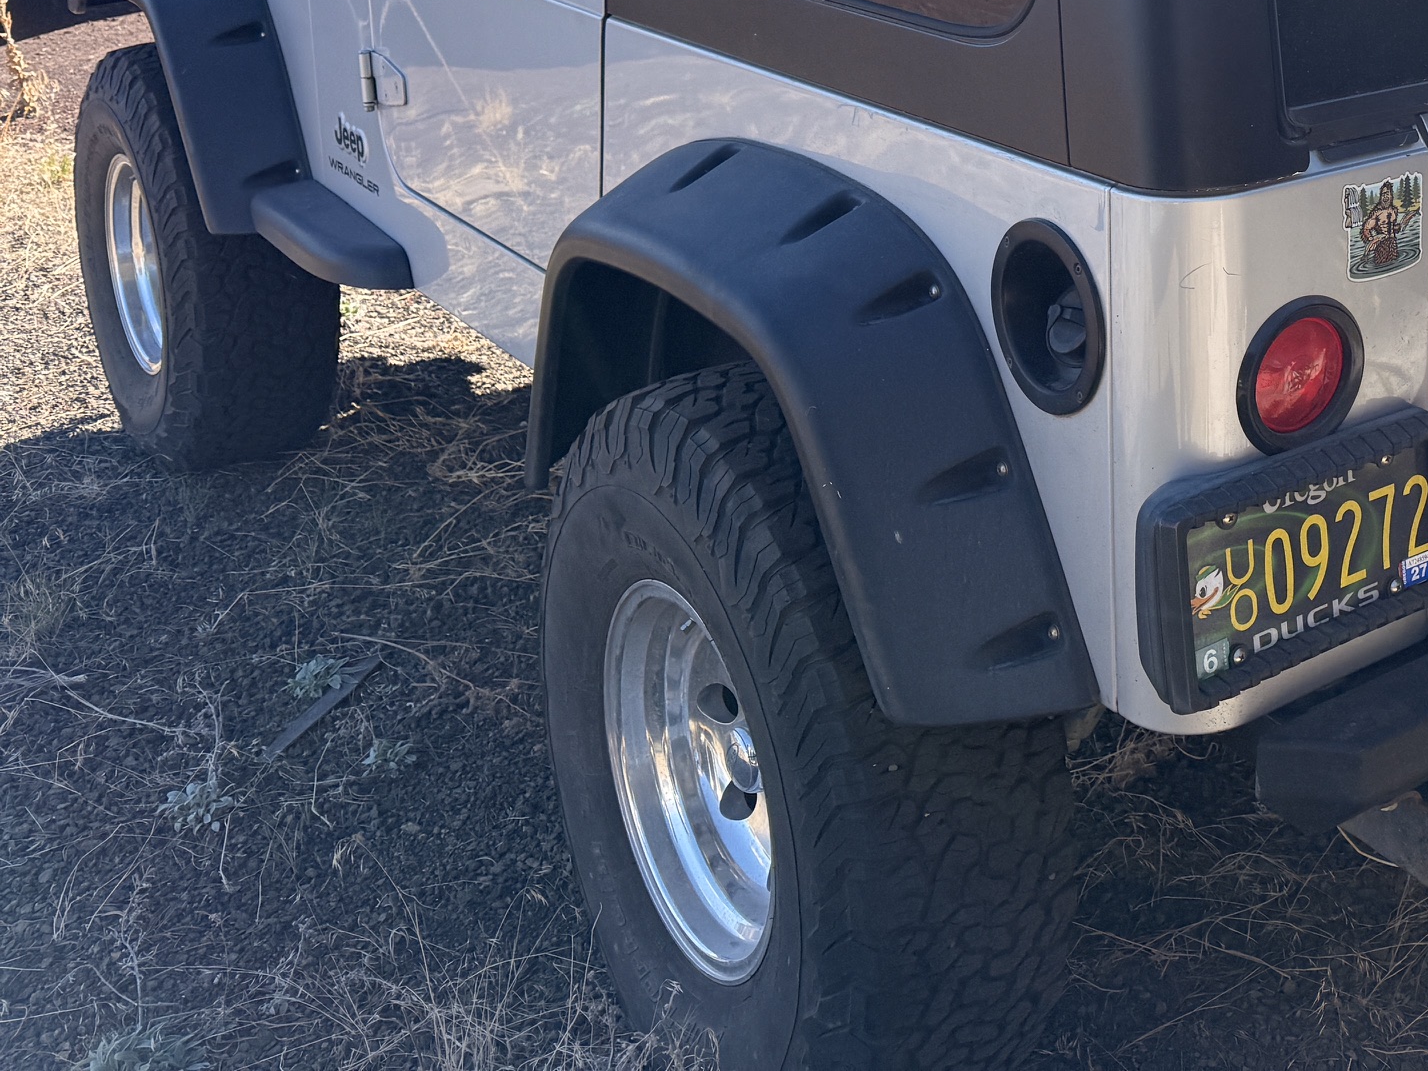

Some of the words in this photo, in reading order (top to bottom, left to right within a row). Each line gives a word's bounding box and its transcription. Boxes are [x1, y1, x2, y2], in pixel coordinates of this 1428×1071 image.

[334, 115, 365, 162] Jeep
[328, 155, 380, 198] WRANGLER
[1410, 562, 1428, 582] 27
[1252, 581, 1380, 653] DUCKS
[1203, 648, 1218, 674] 6
